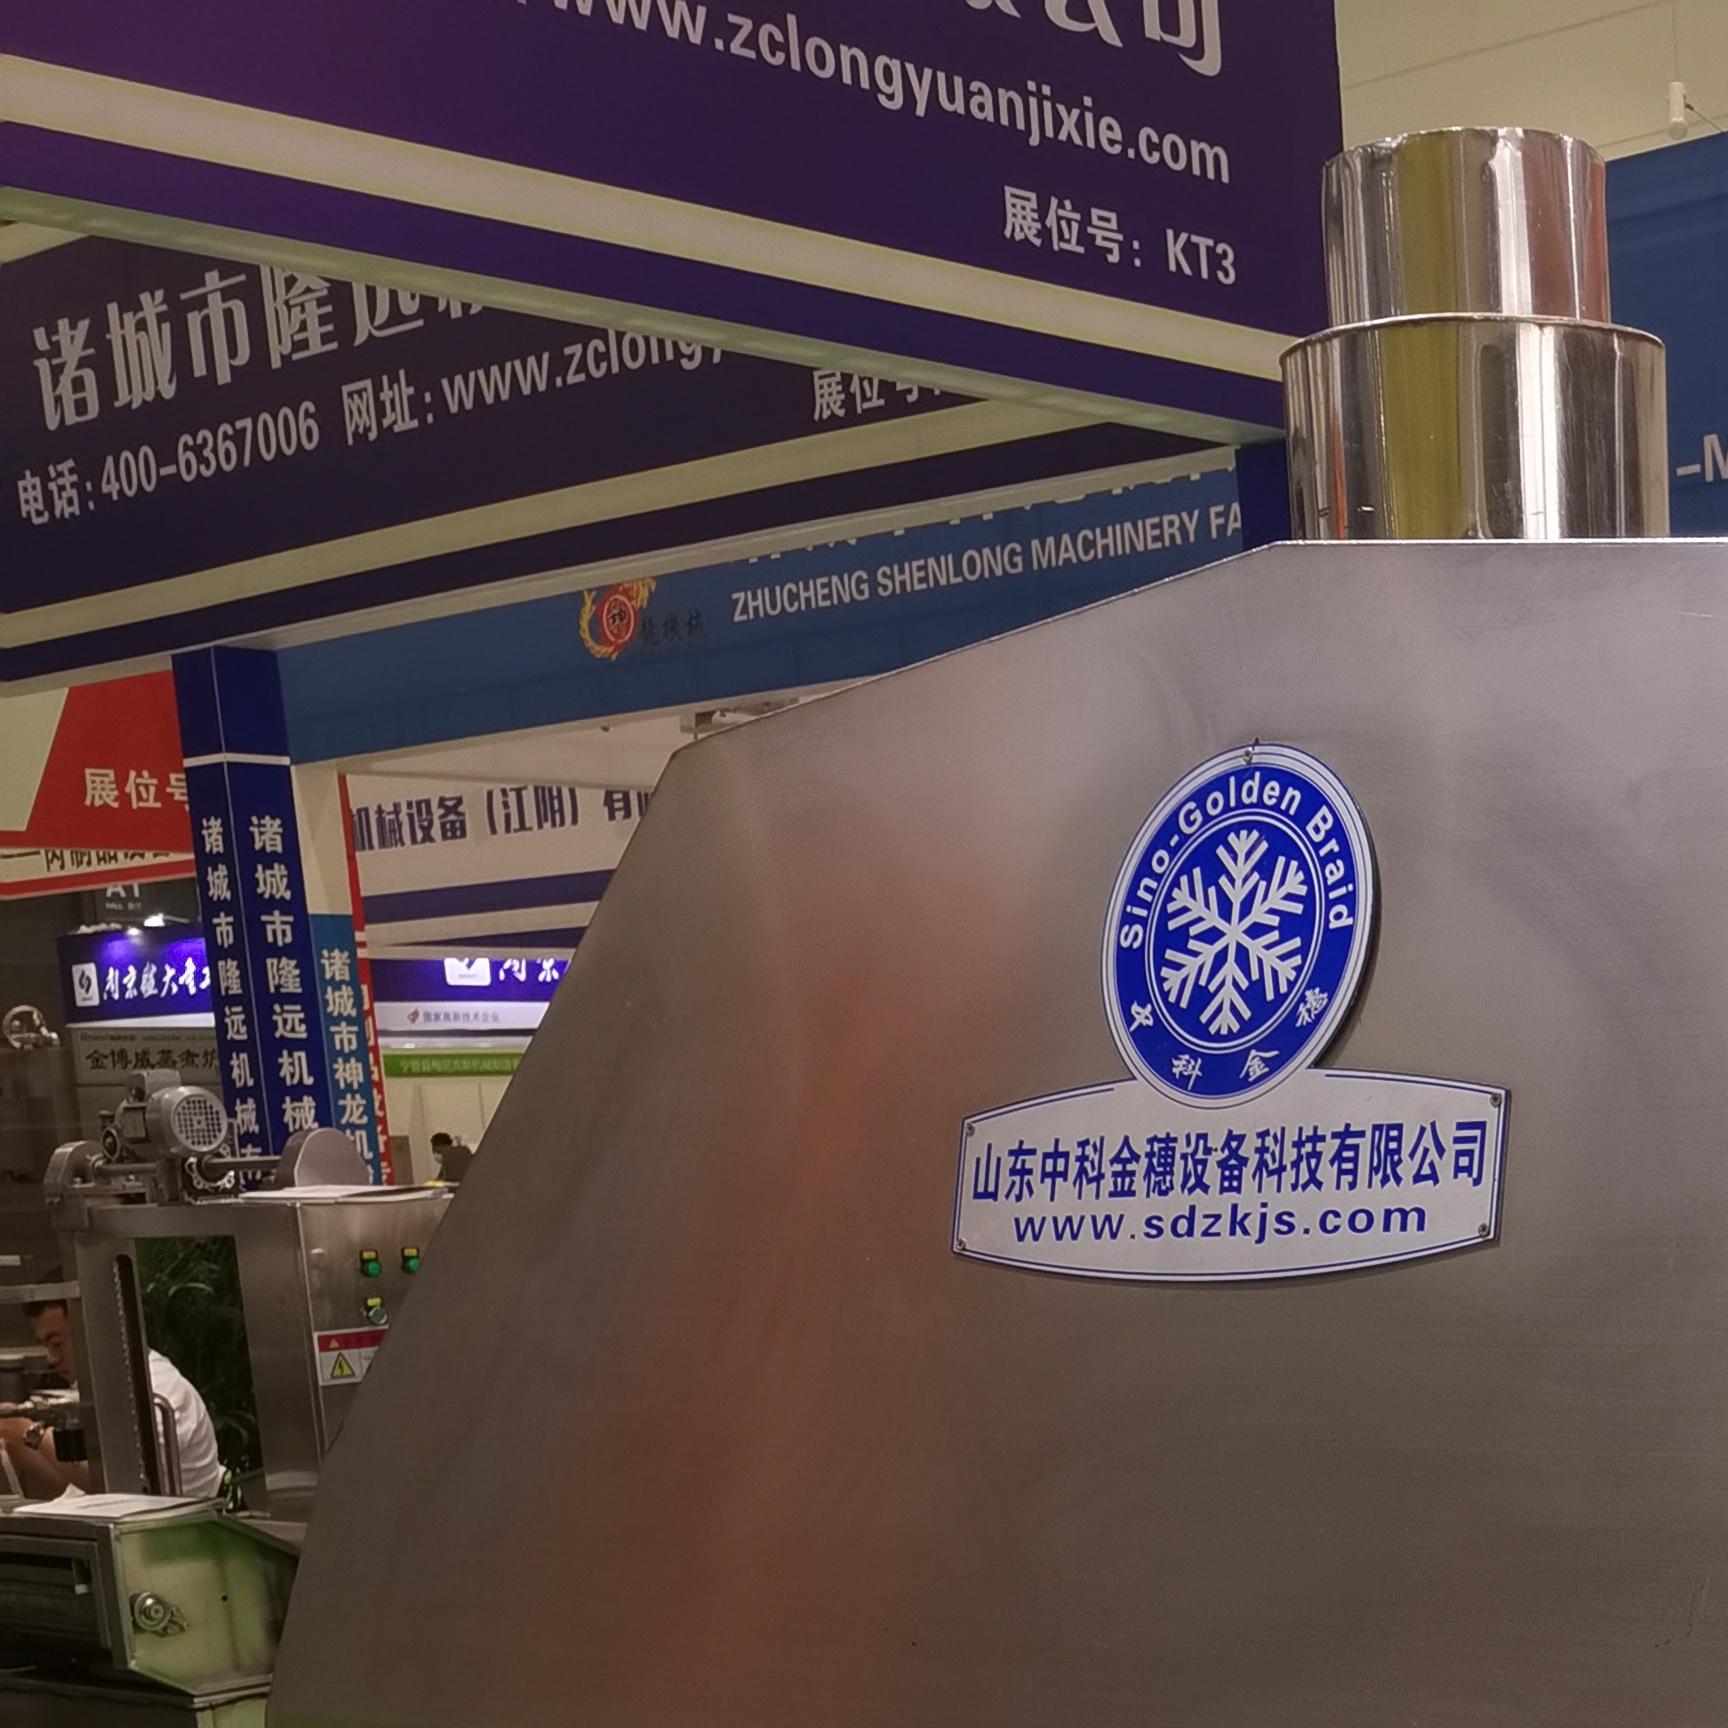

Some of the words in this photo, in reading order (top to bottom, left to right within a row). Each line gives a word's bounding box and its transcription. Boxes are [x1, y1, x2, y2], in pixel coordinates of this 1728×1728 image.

[732, 569, 870, 623] ZHUCHENG
[876, 543, 1024, 597] SHENLONG
[1031, 508, 1200, 570] MACHINERY
[1118, 771, 1302, 949] Sino-Golden
[1306, 805, 1354, 930] Braid
[971, 1119, 1489, 1204] 山东中科金穗设备科技有限公司
[1013, 1201, 1428, 1245] www.sdzkjs.com
